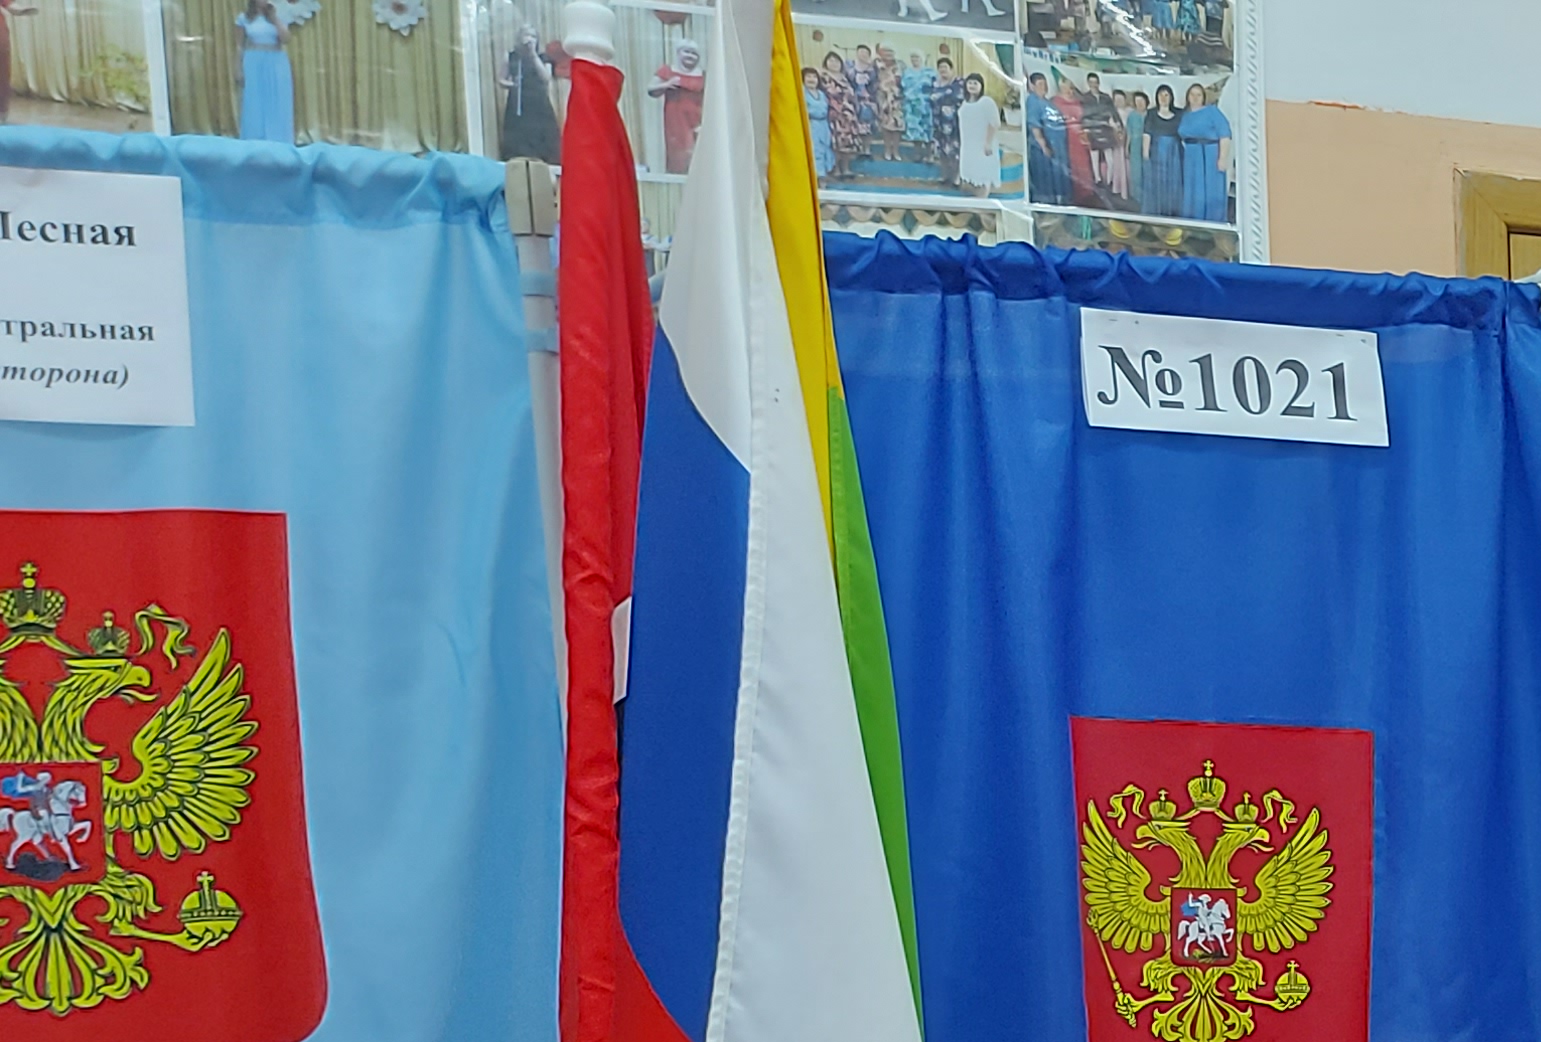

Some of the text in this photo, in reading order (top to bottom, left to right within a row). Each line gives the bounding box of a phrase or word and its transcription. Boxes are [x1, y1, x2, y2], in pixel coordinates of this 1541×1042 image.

[0, 318, 156, 343] тральная
[0, 363, 130, 390] торона)
[1097, 344, 1358, 422] №1021
